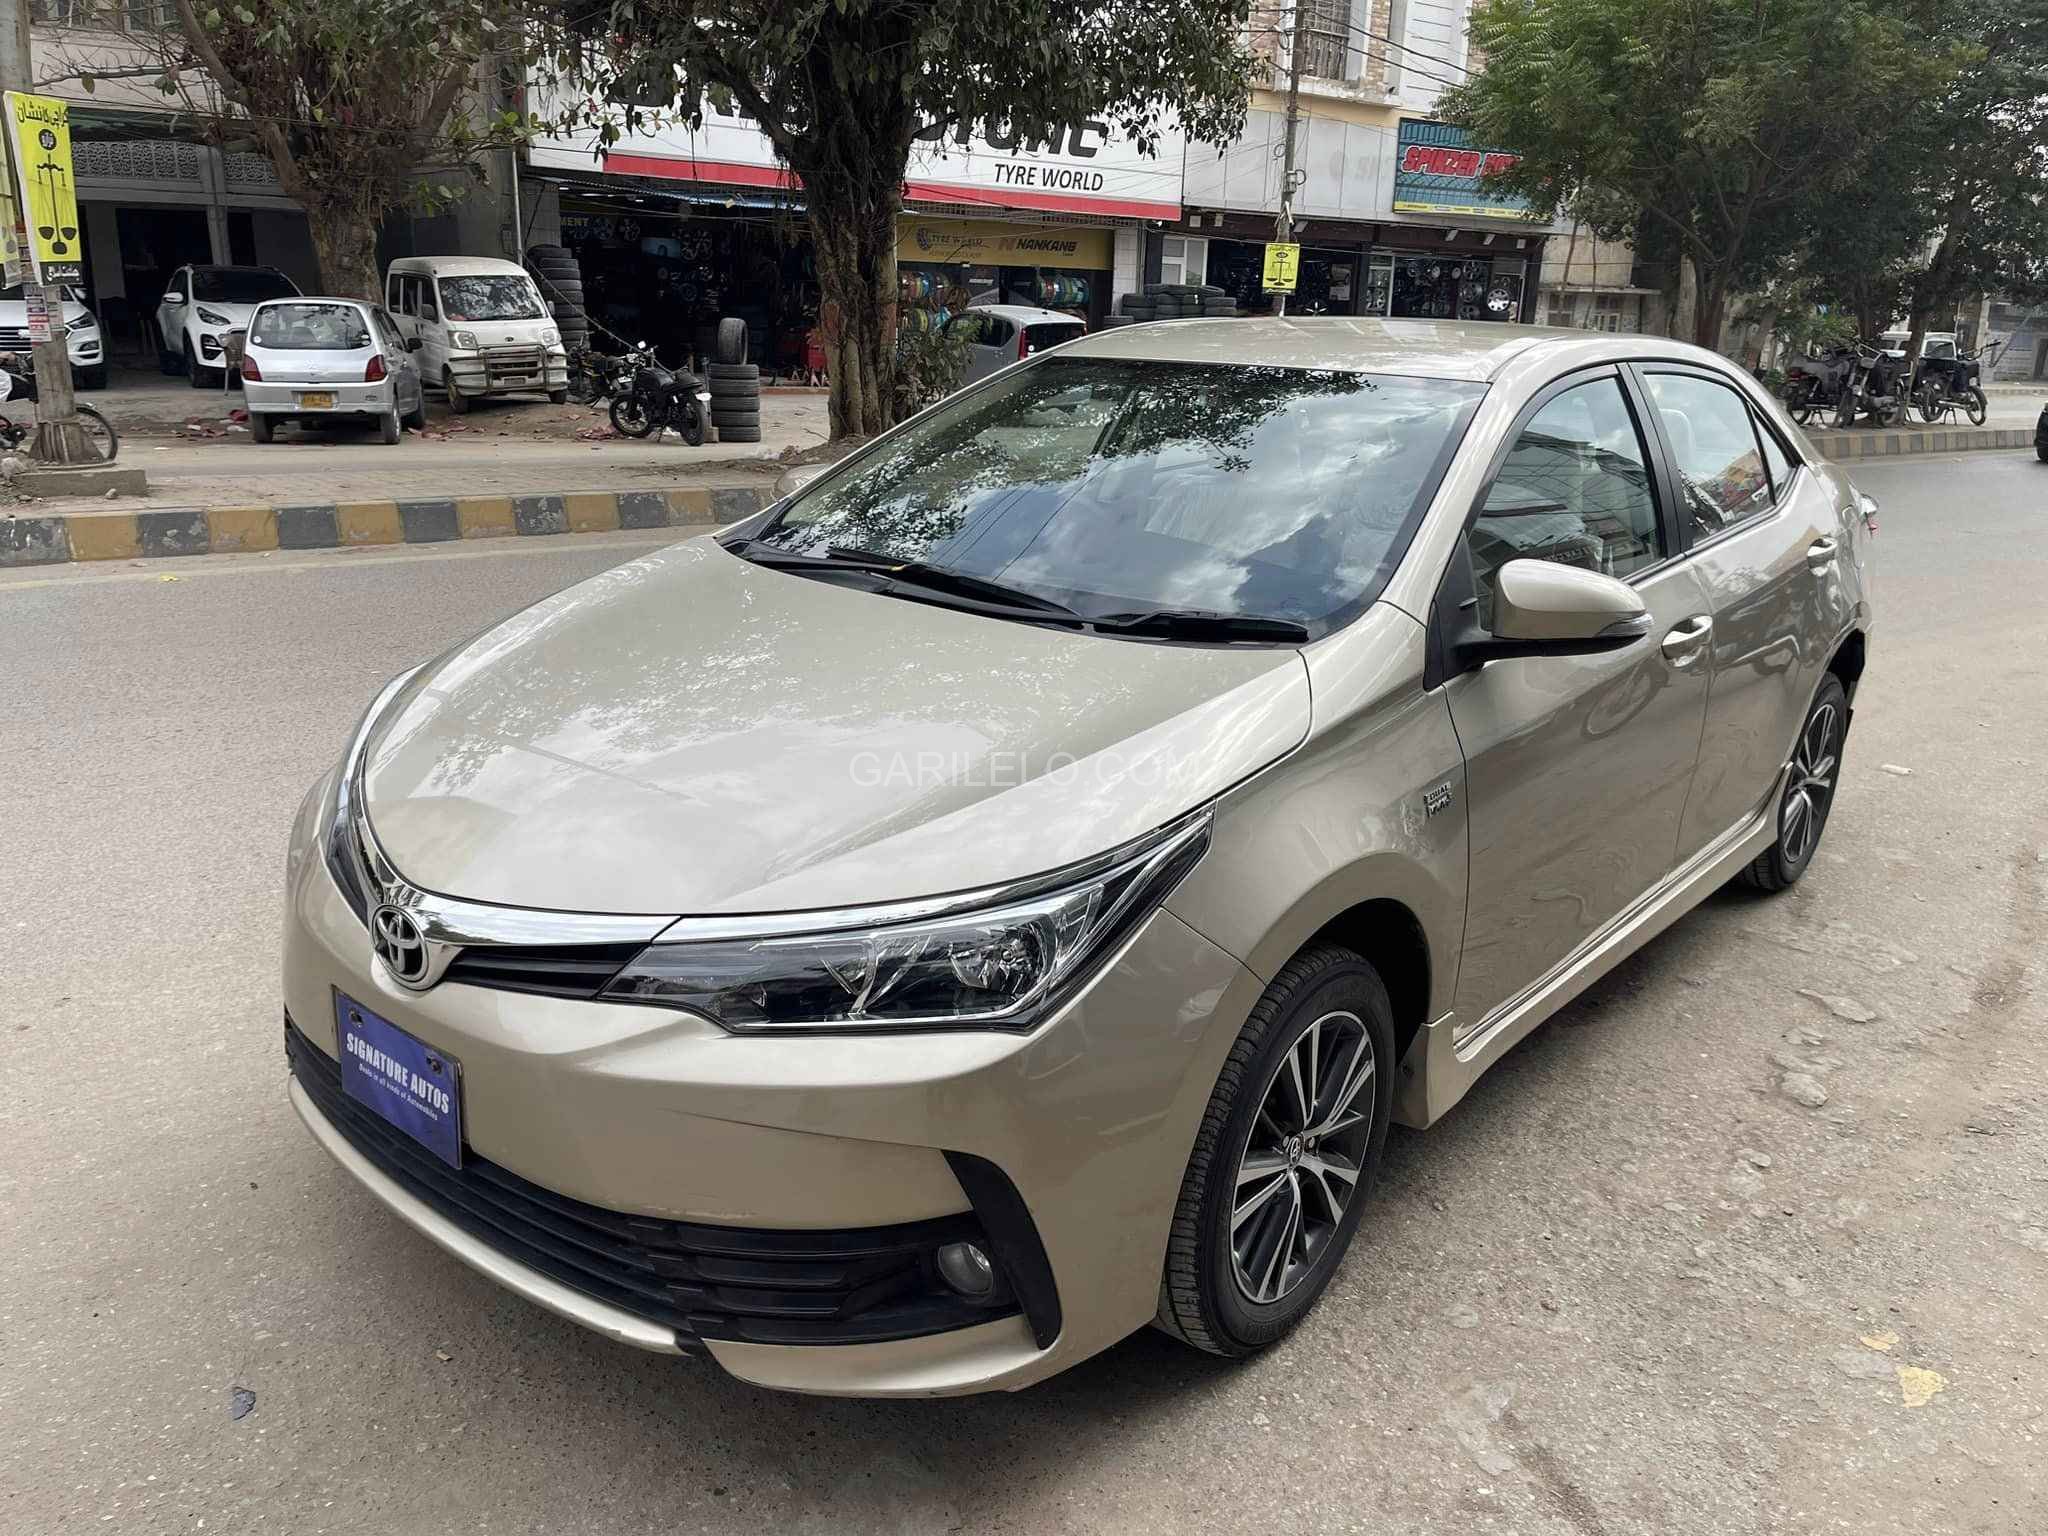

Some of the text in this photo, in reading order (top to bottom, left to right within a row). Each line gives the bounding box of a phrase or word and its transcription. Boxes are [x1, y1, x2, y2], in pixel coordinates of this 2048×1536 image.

[995, 163, 1103, 191] TYRE WORLD
[346, 1033, 450, 1115] SIGNATURE AUTOS
